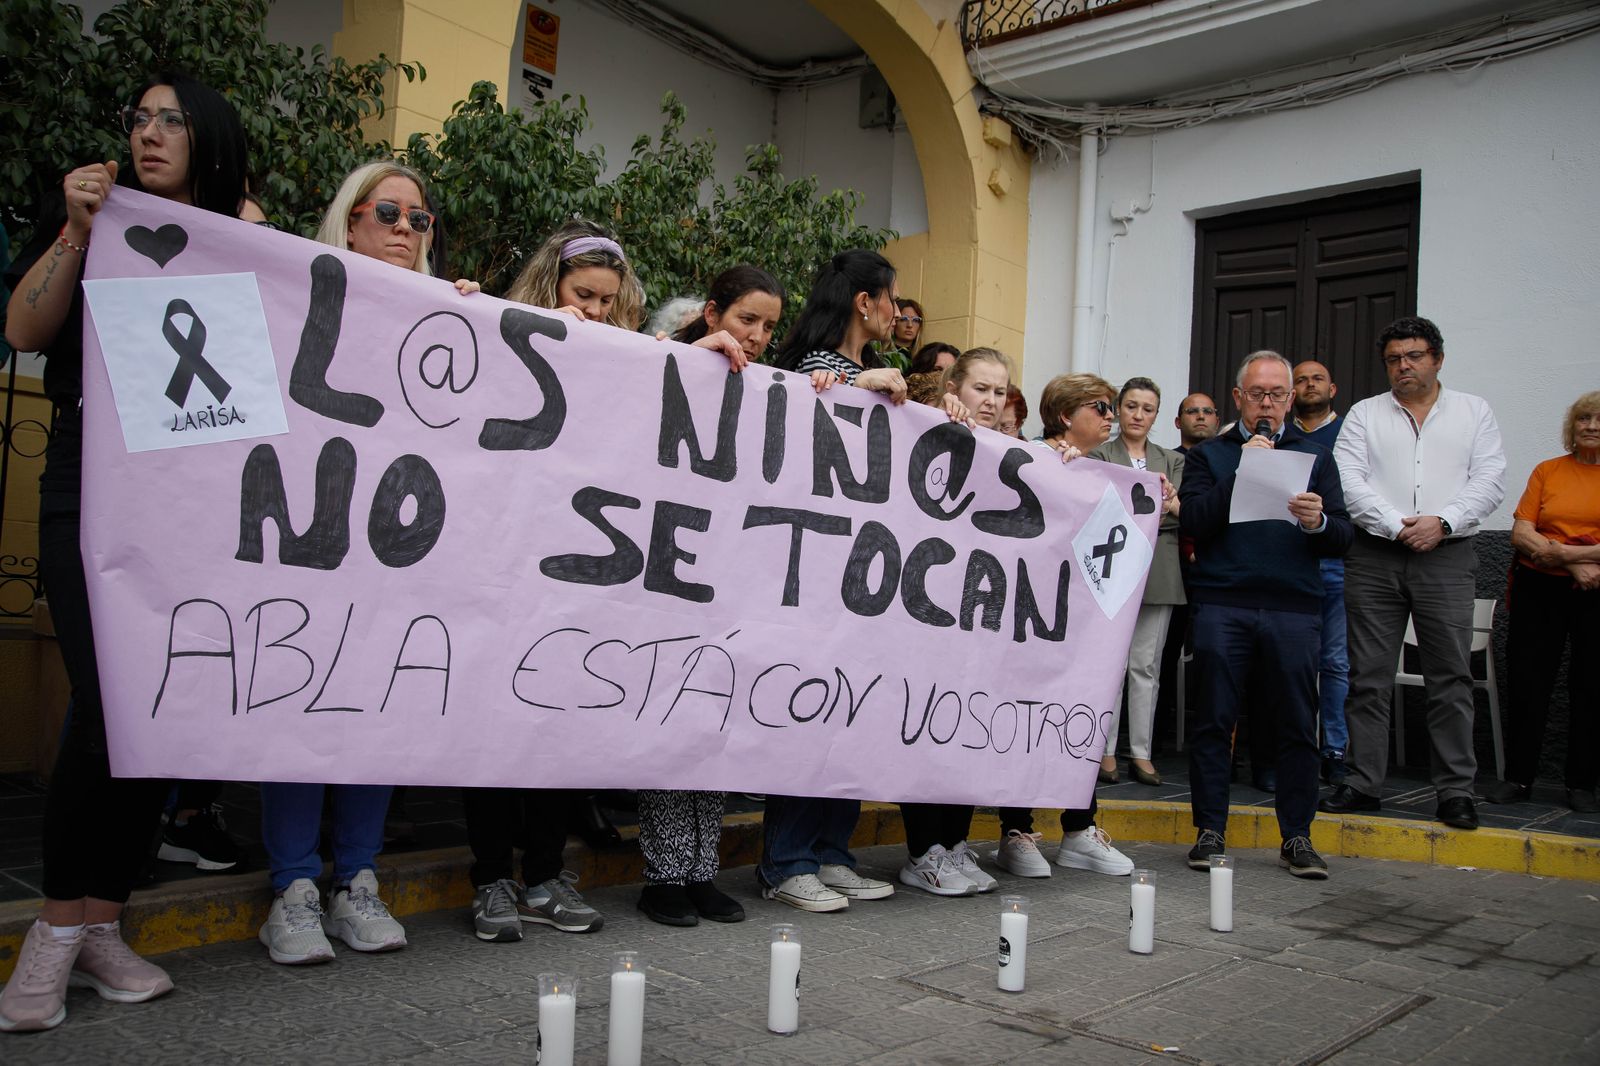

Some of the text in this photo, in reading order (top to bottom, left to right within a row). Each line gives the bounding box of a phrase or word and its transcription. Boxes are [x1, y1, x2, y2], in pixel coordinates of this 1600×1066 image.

[289, 253, 568, 451] L@S
[234, 436, 1071, 643] NO SE TOCAN
[152, 598, 451, 718] ABLA
[513, 628, 742, 732] ESTÁ
[749, 663, 882, 728] CON
